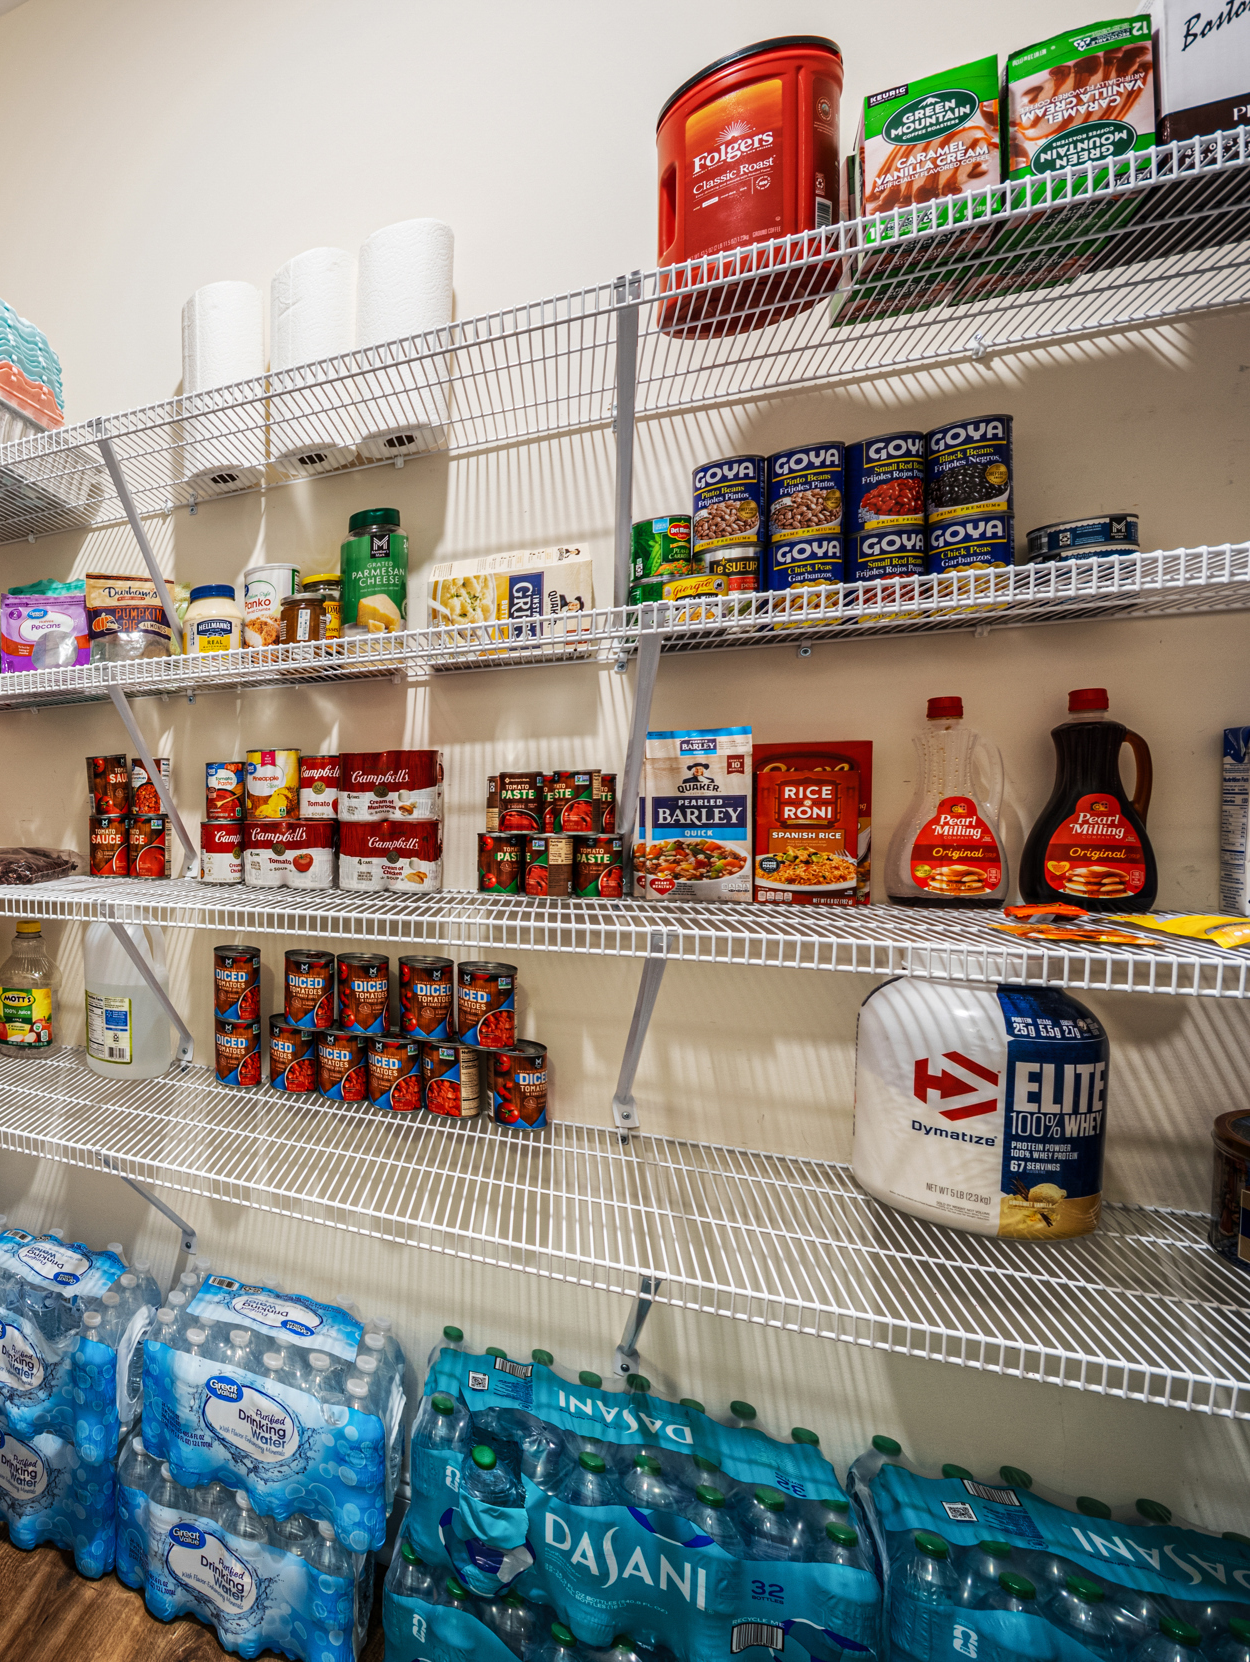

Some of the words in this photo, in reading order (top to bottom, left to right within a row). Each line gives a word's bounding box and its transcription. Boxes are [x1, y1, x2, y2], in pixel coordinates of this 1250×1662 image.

[1132, 21, 1149, 35] 12
[870, 86, 906, 103] KEURIG
[1079, 79, 1145, 101] VANILLA
[902, 99, 956, 123] GREEN
[1020, 97, 1077, 122] CREAM
[1045, 96, 1121, 123] CARAMEL
[890, 105, 970, 138] MOUNTAIN
[903, 129, 926, 140] COFFEE
[927, 119, 959, 133] ROASTERS
[692, 131, 774, 175] Folgers
[1040, 130, 1127, 162] MOUNTAIN
[896, 141, 967, 168] CARAMEL
[1055, 144, 1114, 168] GREEN
[874, 160, 934, 185] VANILLA
[936, 145, 989, 166] CREAM
[693, 169, 737, 195] Classic
[739, 156, 774, 175] Roast
[930, 421, 1003, 451] GOYA
[775, 448, 839, 475] GOYA
[939, 452, 964, 463] Black
[966, 447, 994, 456] Beans
[874, 463, 897, 474] Small
[899, 462, 912, 470] Red
[934, 459, 967, 473] Frijoles
[968, 454, 1000, 465] Negros
[695, 462, 754, 489] GOYA
[784, 477, 805, 486] Pinto
[807, 473, 831, 482] Beans
[862, 471, 891, 485] Frijoles
[701, 490, 719, 500] Pinto
[721, 485, 745, 494] Beans
[779, 484, 810, 495] Frijoles
[936, 508, 958, 518] PRIME
[931, 520, 1003, 548] GOYA
[776, 540, 840, 564] GOYA
[940, 549, 967, 559] Chick
[970, 545, 991, 553] Peas
[725, 561, 758, 572] SUEUR
[868, 558, 891, 568] Small
[941, 555, 991, 567] Garbanzos
[352, 568, 405, 580] PARMESAN
[787, 566, 813, 575] Chick
[788, 572, 832, 583] Garbanzos
[359, 576, 400, 586] CHEESE
[103, 586, 158, 599] Durham's
[115, 608, 163, 622] PUMPKIN
[31, 622, 61, 631] Pecans
[122, 620, 137, 632] PIE
[198, 622, 231, 631] HELLMANN'S
[351, 769, 409, 785] Campbell's
[502, 790, 534, 799] PASTE
[677, 783, 720, 793] QUAKER
[784, 786, 832, 799] RICE
[657, 807, 743, 826] BARLEY
[784, 806, 832, 819] RONI
[1078, 812, 1119, 825] Pearl
[939, 814, 976, 826] Pearl
[251, 827, 306, 843] Campbell's
[932, 824, 982, 839] Milling
[1069, 823, 1124, 839] Milling
[92, 835, 121, 844] SAUCE
[368, 836, 419, 850] Campbell's
[577, 854, 611, 863] PASTE
[932, 847, 983, 860] Original
[1069, 847, 1126, 860] Original
[216, 969, 246, 981] DICED
[289, 976, 323, 988] DICED
[290, 986, 322, 994] TOMATOES
[355, 981, 387, 992] DICED
[417, 983, 452, 995] DICED
[4, 995, 31, 1003] MOTT'S
[216, 1035, 246, 1048] DICED
[1013, 1061, 1106, 1114] ELITE
[1010, 1112, 1061, 1138] 100%
[1064, 1113, 1102, 1138] WHEY
[911, 1119, 993, 1147] Dymatize
[1011, 1141, 1043, 1150] PROTEIN
[1045, 1144, 1071, 1152] POWDER
[1010, 1149, 1031, 1158] 100%
[1033, 1151, 1053, 1159] WHEY
[1054, 1152, 1078, 1160] PROTEIN
[1010, 1161, 1025, 1172] 67
[1027, 1162, 1060, 1171] SERVINGS
[956, 1189, 964, 1199] LB
[1009, 1200, 1033, 1208] GOURMET
[242, 1302, 289, 1318] Drinking
[210, 1379, 238, 1394] Great
[216, 1388, 237, 1399] Value
[238, 1408, 286, 1440] Drinking
[255, 1408, 286, 1426] Purified
[559, 1390, 694, 1444] DASANI
[250, 1427, 286, 1449] Water
[1, 1454, 37, 1480] Drinking
[10, 1469, 38, 1488] Water
[172, 1527, 200, 1541] Great
[178, 1535, 200, 1546] Value
[544, 1511, 706, 1611] DASANI
[201, 1555, 244, 1594] Drinking
[213, 1574, 245, 1602] Water
[751, 1580, 784, 1596] 32
